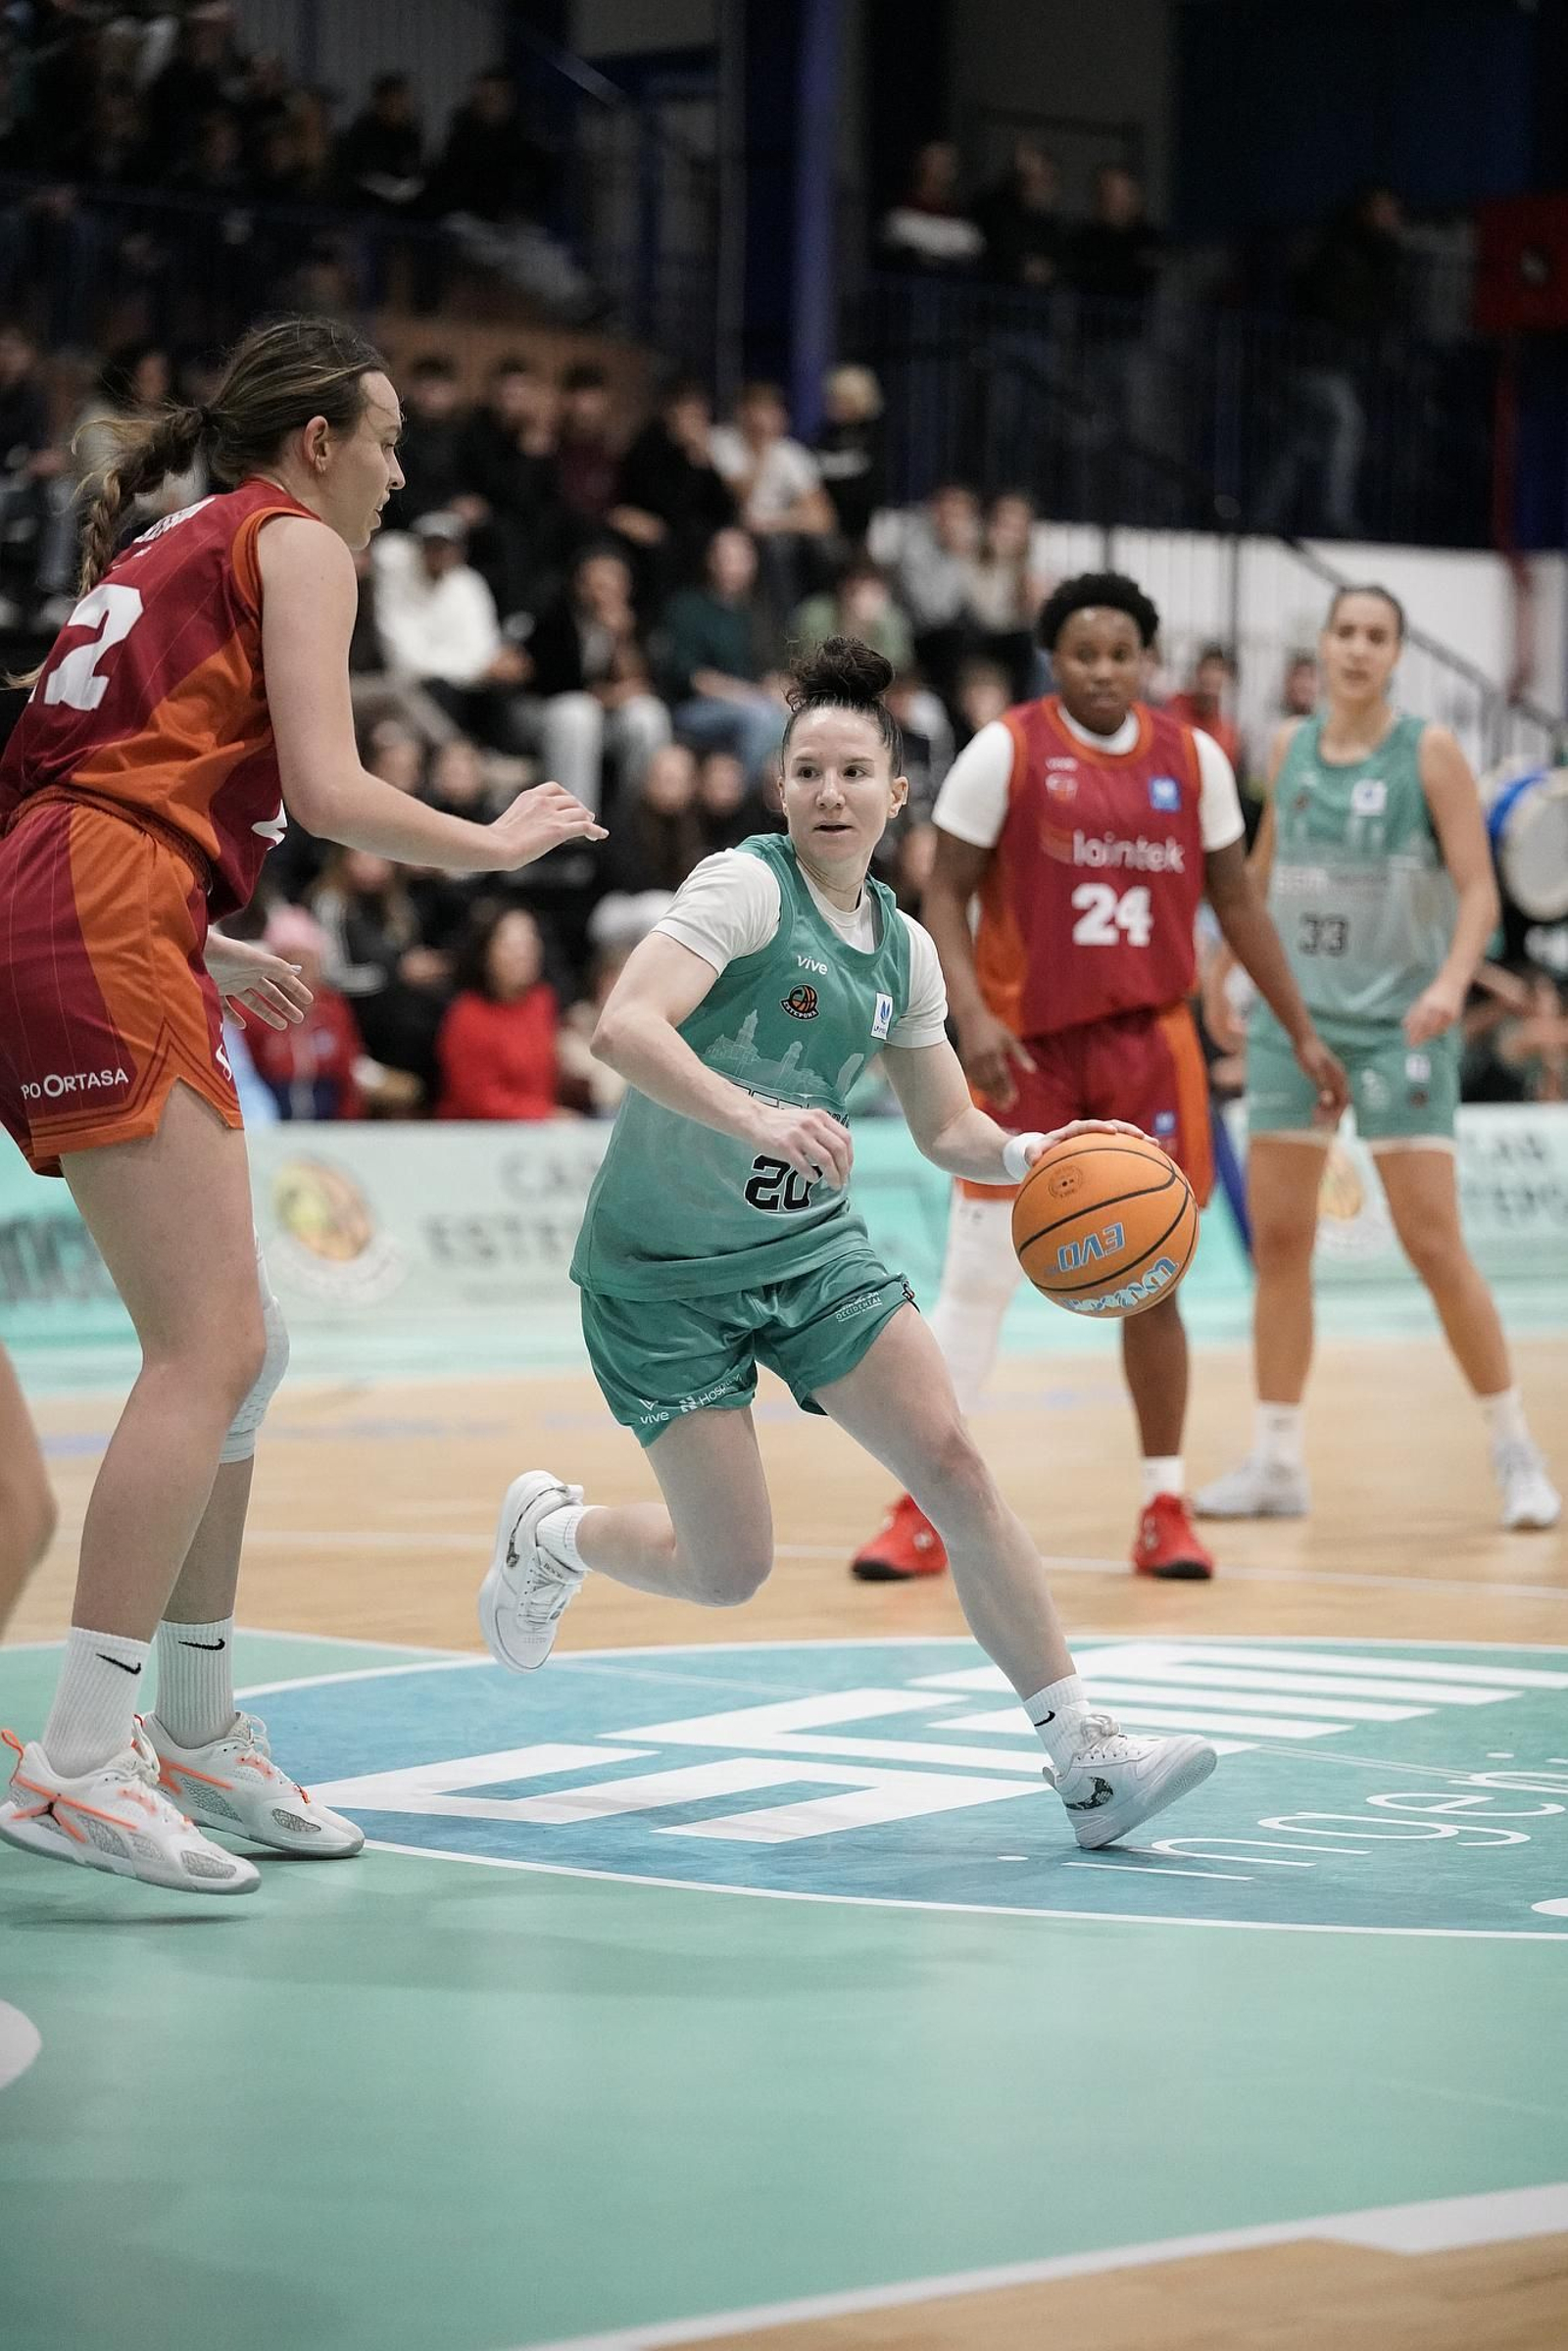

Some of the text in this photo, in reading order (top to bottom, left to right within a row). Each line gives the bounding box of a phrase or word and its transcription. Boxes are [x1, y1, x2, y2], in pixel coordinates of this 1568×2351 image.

[27, 583, 144, 711] 2
[1071, 883, 1155, 948] 24
[1297, 911, 1351, 958] 33
[797, 954, 829, 976] vive
[43, 1067, 129, 1098] ORTASA
[743, 1153, 825, 1212] 20
[1057, 1221, 1126, 1273] EVO
[639, 1409, 670, 1426] vive
[998, 1752, 1568, 1882] ingen
